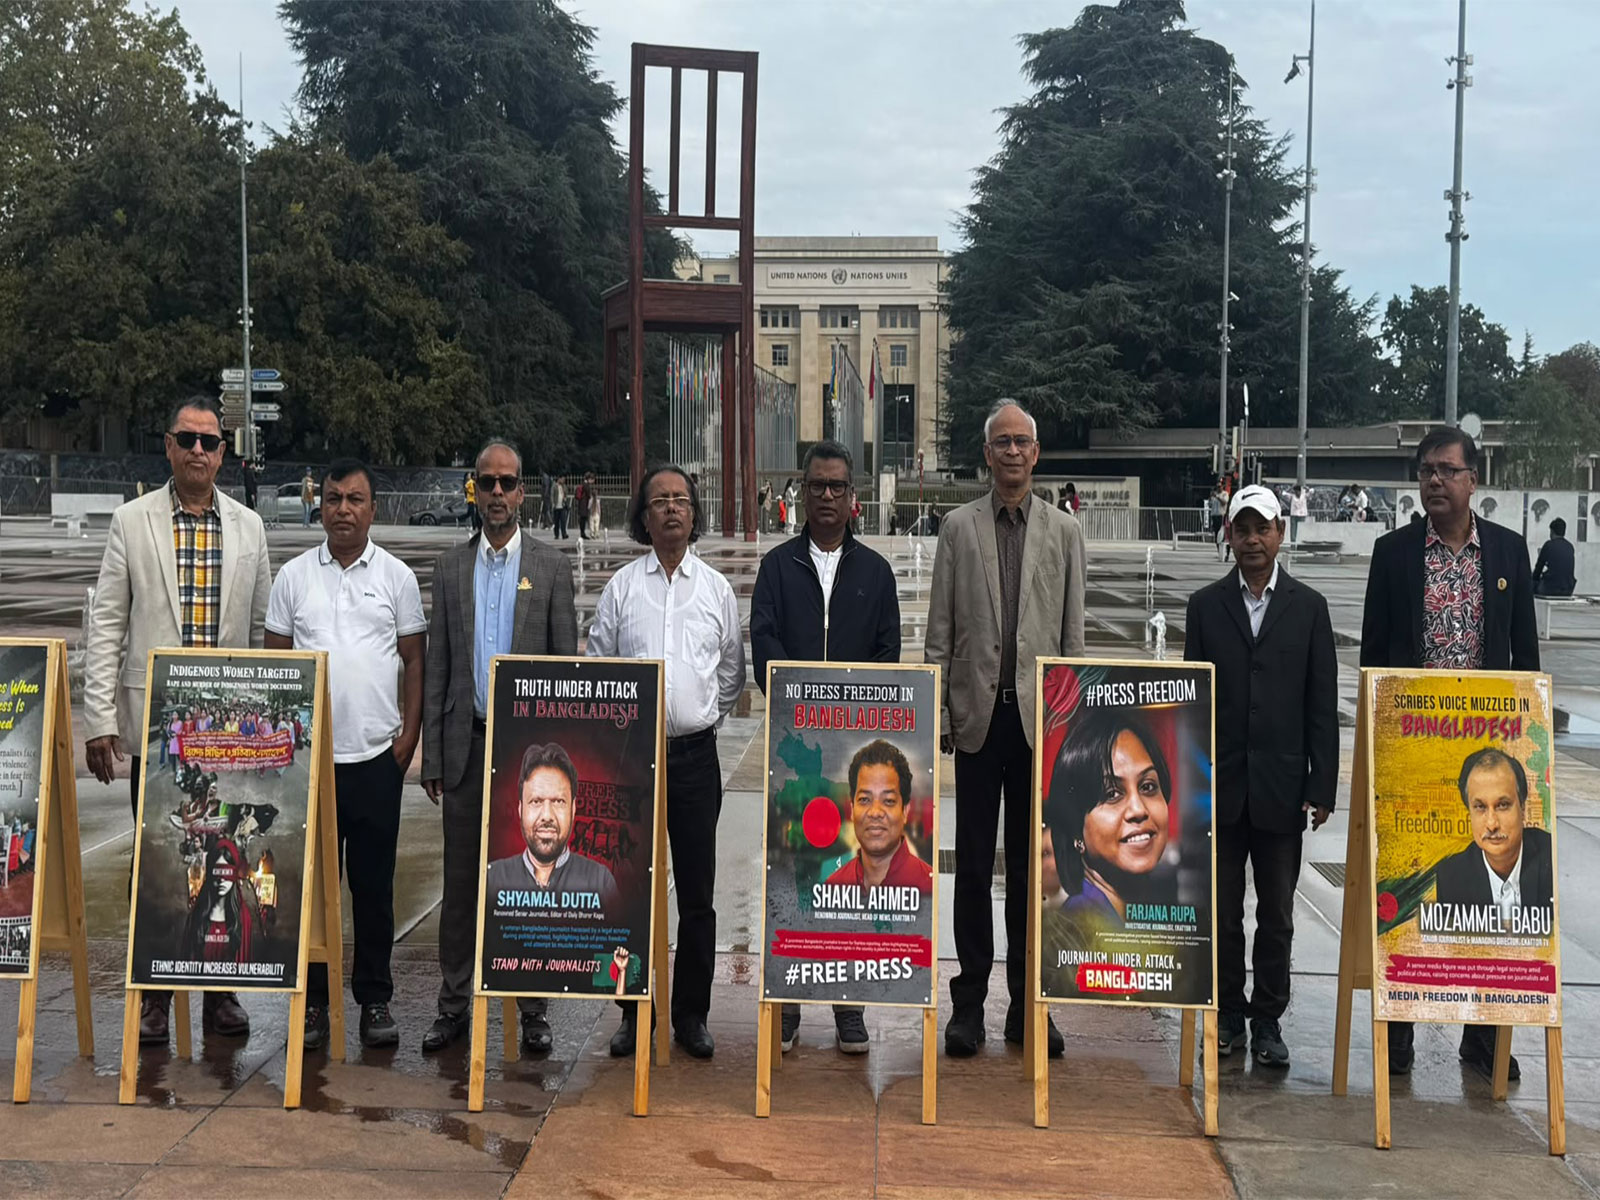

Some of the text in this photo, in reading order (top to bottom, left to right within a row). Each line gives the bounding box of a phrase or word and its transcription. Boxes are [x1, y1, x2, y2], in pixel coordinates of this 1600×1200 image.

[771, 272, 827, 280] UNITED NATIONS
[850, 272, 908, 280] NATIONS UNIES
[1103, 490, 1130, 500] UNIES
[170, 664, 300, 680] INDIGENOUS WOMEN TARGETED
[11, 679, 40, 696] When
[514, 678, 638, 700] TRUTH UNDER ATTACK
[786, 684, 914, 702] NO PRESS FREEDOM IN
[1086, 678, 1196, 708] #PRESS FREEDOM
[16, 698, 25, 714] Is
[1394, 694, 1530, 713] SCRIBES VOICE MUZZLED IN
[513, 700, 639, 730] IN BANGLADESH
[794, 704, 916, 732] BANGLADESH
[1401, 714, 1522, 742] BANGLADESH
[577, 782, 616, 800] FREE
[576, 798, 630, 819] PRESS
[1395, 810, 1452, 834] freedom
[497, 890, 601, 910] SHYAMAL DUTTA
[812, 883, 920, 912] SHAKIL AHMED
[1126, 903, 1197, 923] FARJANA RUPA
[1420, 902, 1551, 936] MOZAMMEL BABU
[152, 960, 285, 976] ETHNIC IDENTITY INCREASES VULNERABILITY
[491, 958, 601, 973] STAND WITH JOURNALISTS
[1058, 950, 1108, 968] JOURNALISM
[1112, 952, 1141, 968] UNDER
[1145, 954, 1174, 970] ATTACK
[784, 956, 913, 986] #FREE PRESS
[1397, 970, 1416, 978] political
[1432, 972, 1449, 980] raising
[1514, 974, 1539, 982] journalists
[1442, 964, 1457, 972] figure
[1476, 964, 1496, 974] through
[1497, 966, 1508, 974] legal
[1510, 966, 1528, 976] scrutiny
[1086, 969, 1172, 992] BANGLADESH
[1388, 991, 1550, 1005] MEDIA FREEDOM IN BANGLADESH
